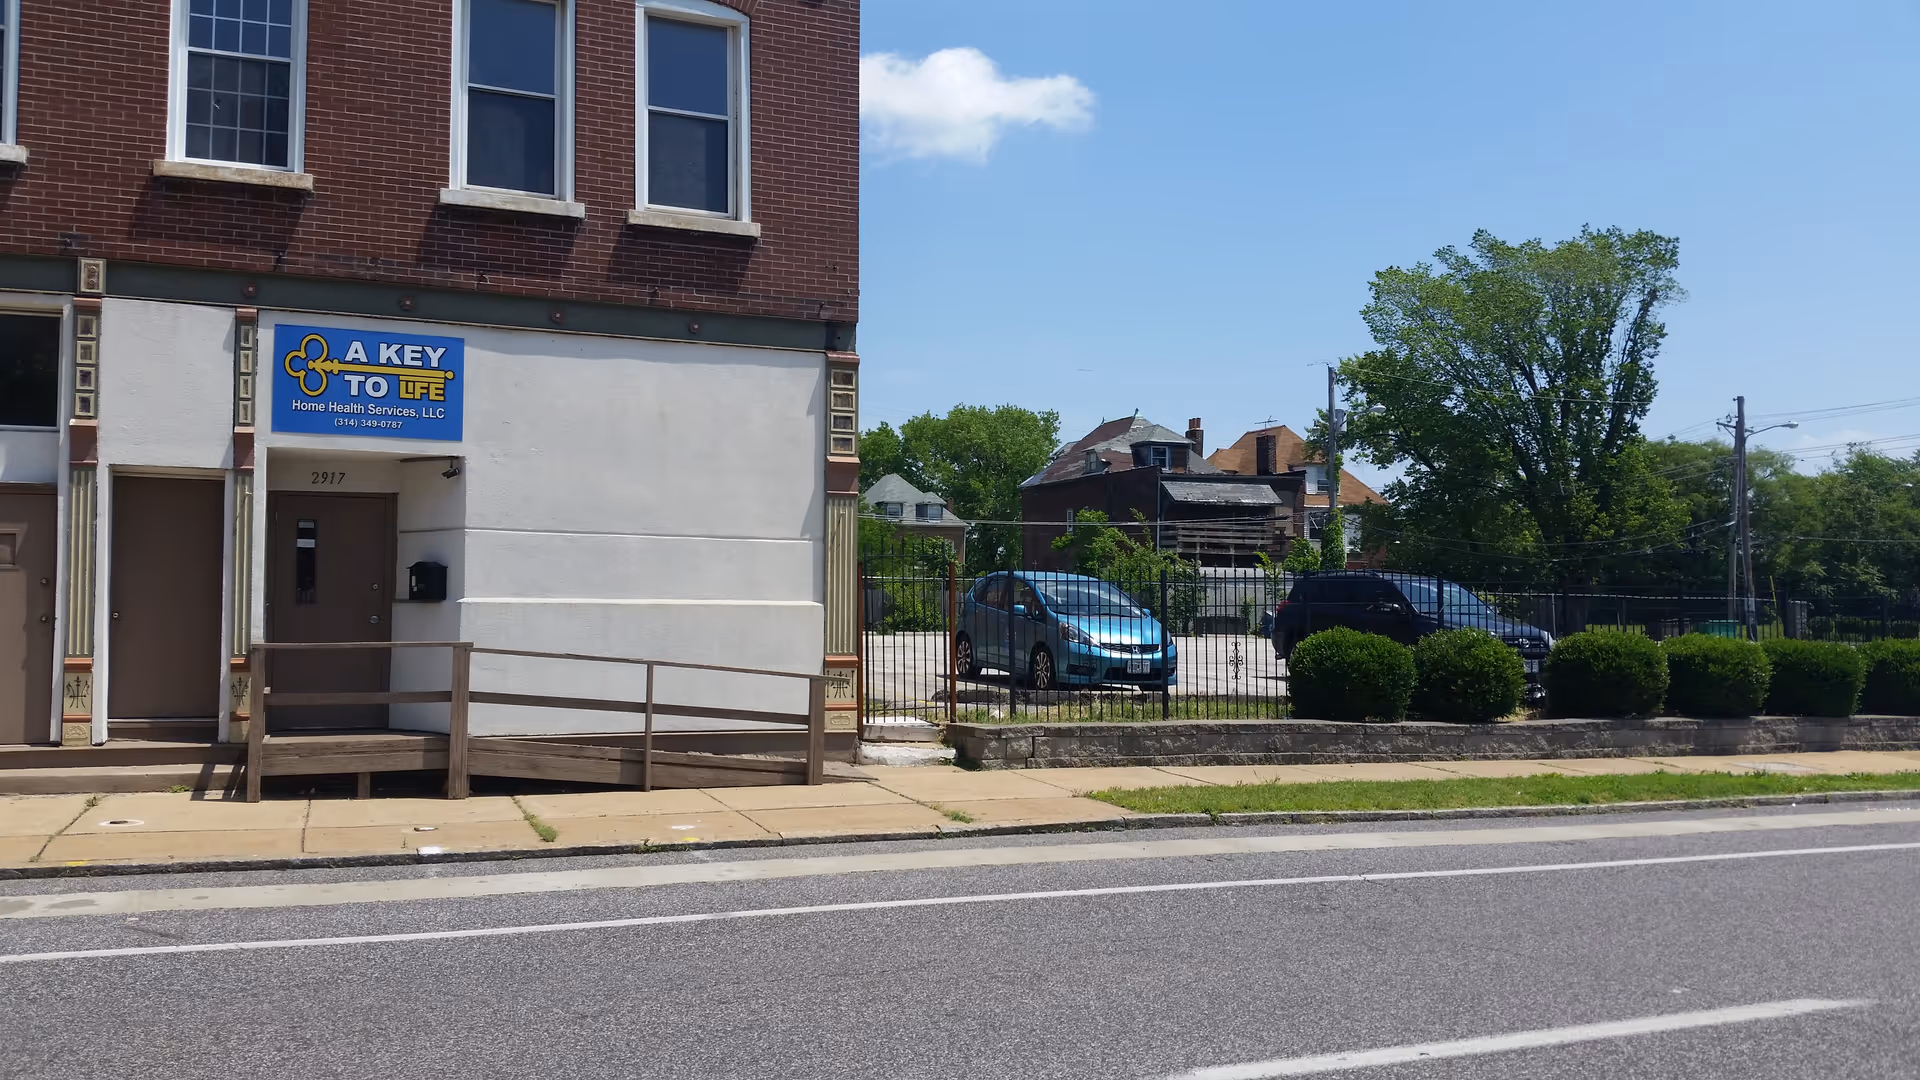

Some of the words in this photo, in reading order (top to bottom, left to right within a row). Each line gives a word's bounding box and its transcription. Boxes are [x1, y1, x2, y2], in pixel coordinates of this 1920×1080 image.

[344, 340, 369, 364] A
[378, 342, 447, 368] KEY
[344, 374, 388, 398] TO
[398, 380, 445, 401] LIFE
[292, 399, 326, 412] Home
[328, 401, 365, 415] Health
[367, 404, 419, 419] Services,
[421, 407, 445, 419] LLC
[334, 418, 358, 428] (314)
[360, 419, 403, 429] 349-0787
[311, 471, 346, 485] 2917
